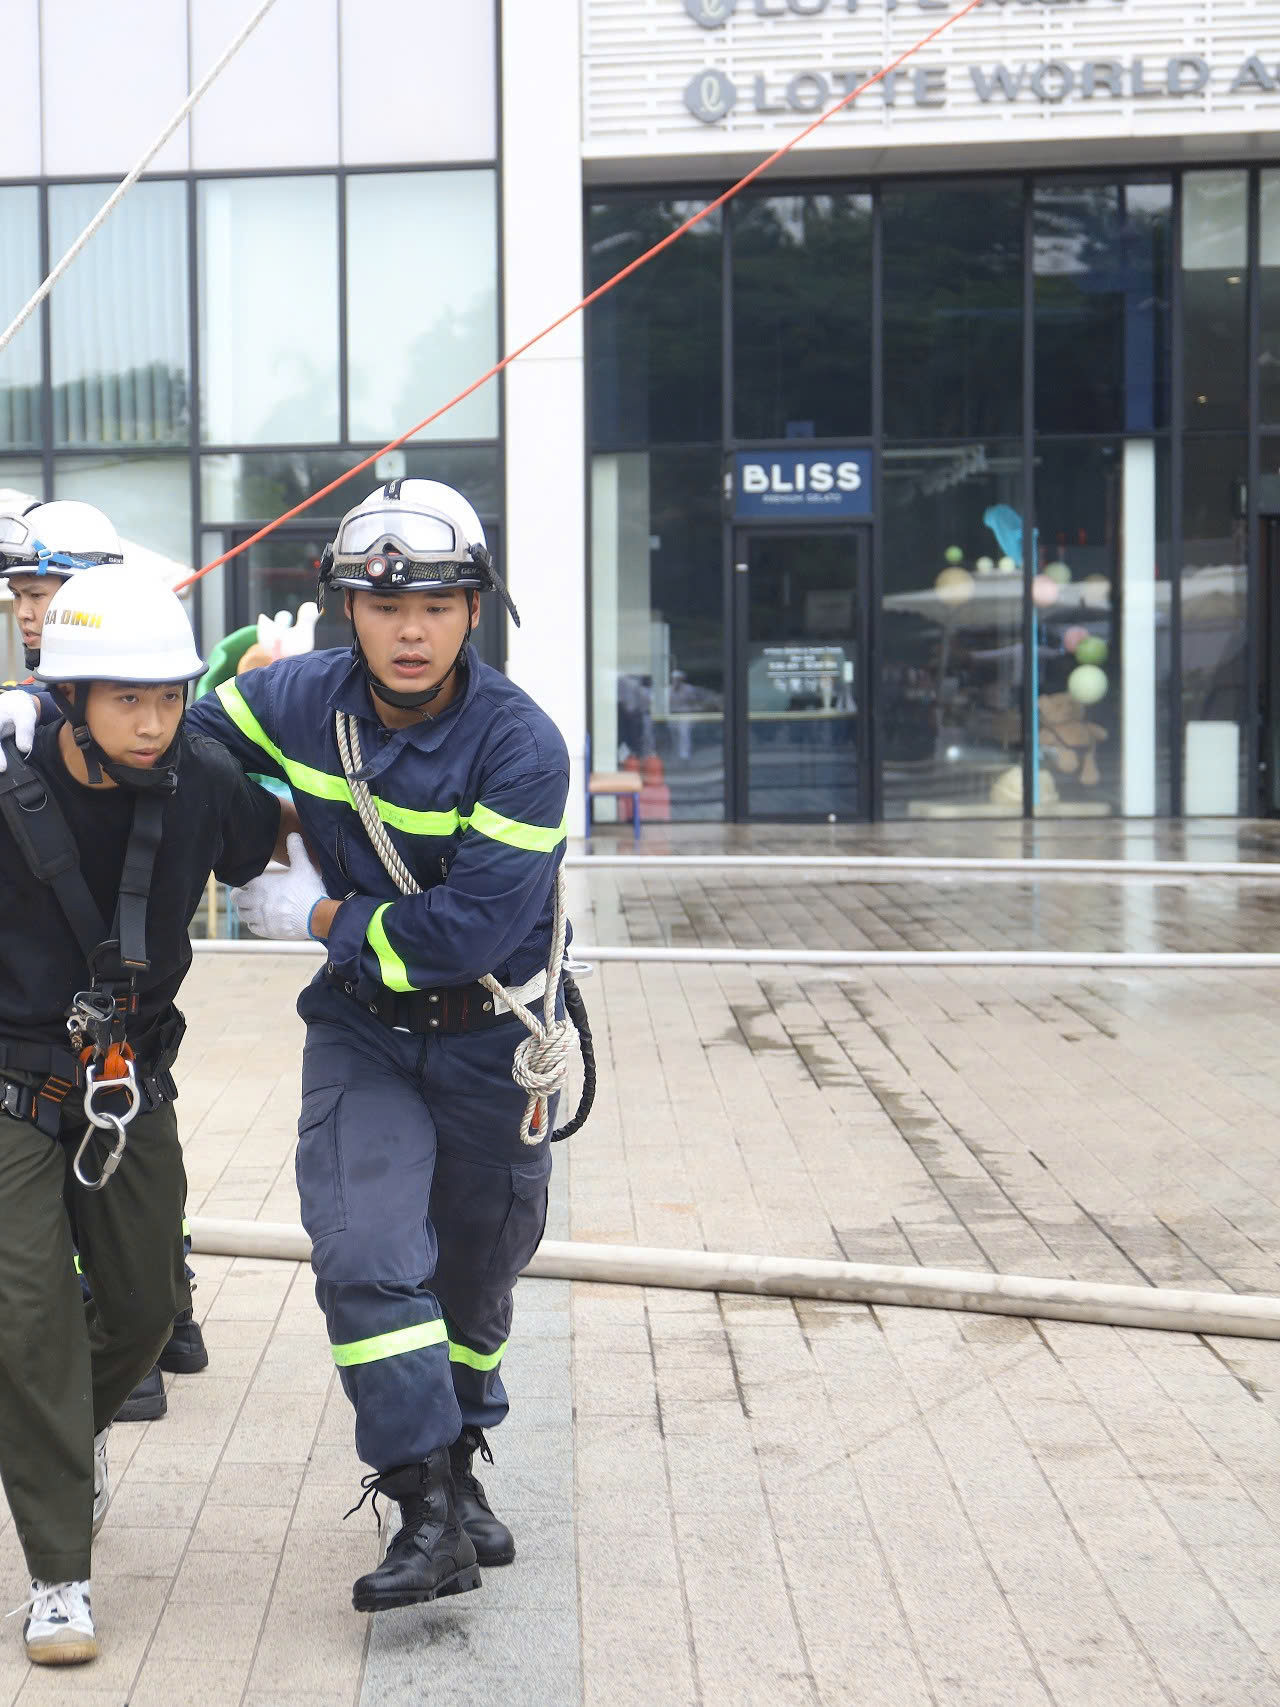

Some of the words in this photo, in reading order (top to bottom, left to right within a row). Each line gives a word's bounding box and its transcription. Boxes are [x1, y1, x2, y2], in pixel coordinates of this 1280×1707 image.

[754, 68, 947, 114] LOTTE
[969, 55, 1211, 103] WORLD
[1230, 53, 1280, 95] A
[743, 461, 862, 493] BLISS
